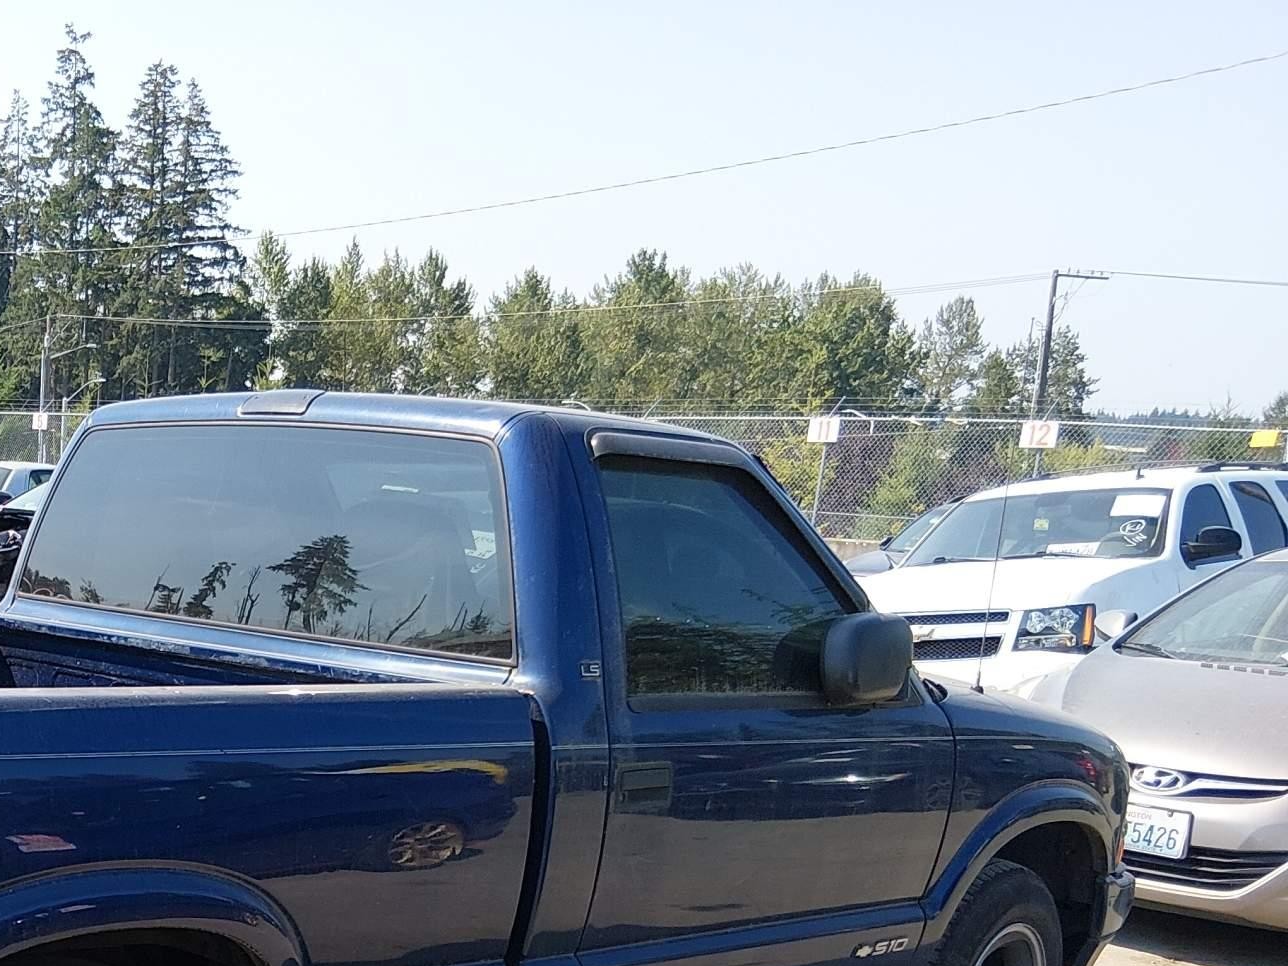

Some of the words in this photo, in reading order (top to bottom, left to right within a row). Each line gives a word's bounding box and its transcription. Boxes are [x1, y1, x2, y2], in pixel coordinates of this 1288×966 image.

[818, 420, 831, 440] 11
[1029, 423, 1051, 445] 12
[580, 664, 600, 676] LS
[872, 938, 908, 956] S10
